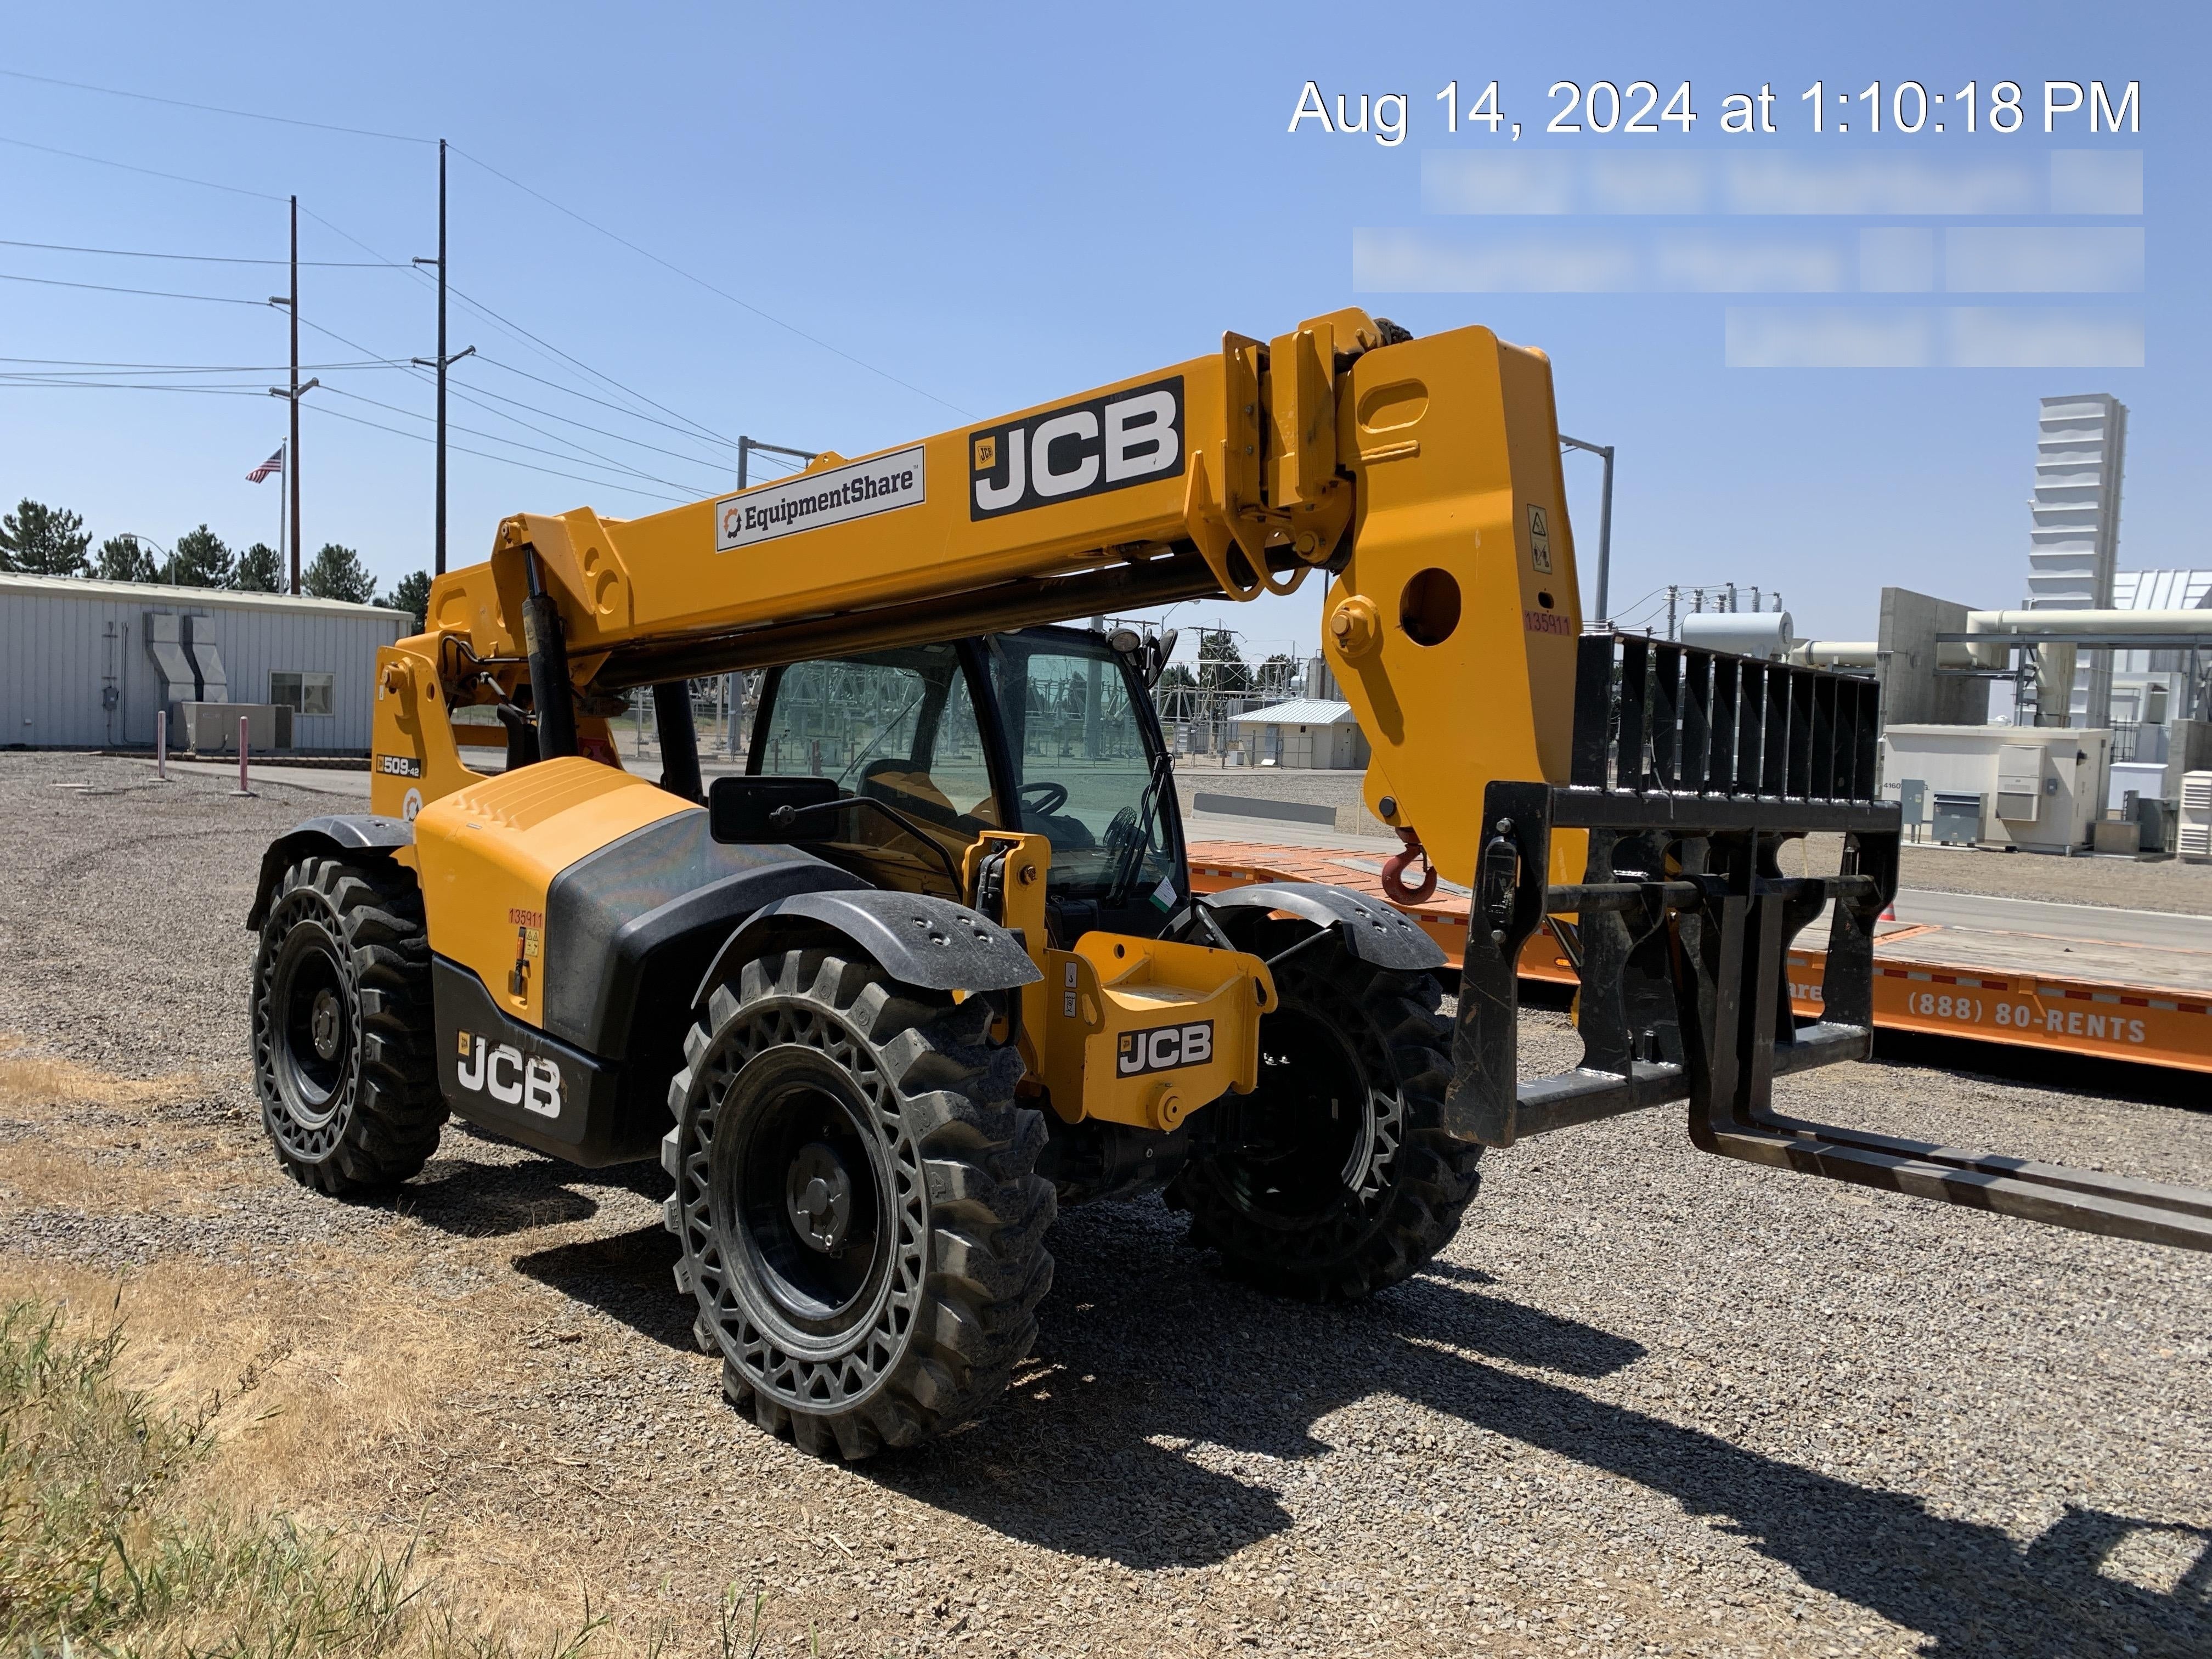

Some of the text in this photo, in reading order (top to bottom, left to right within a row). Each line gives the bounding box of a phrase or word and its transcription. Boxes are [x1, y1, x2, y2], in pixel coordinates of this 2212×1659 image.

[975, 391, 1179, 510] JCB
[744, 470, 913, 531] EquipmentShare
[1525, 611, 1570, 635] 135911
[510, 908, 543, 928] 135911
[1789, 983, 1823, 1001] are
[1909, 991, 1982, 1023] (888)
[1120, 1024, 1211, 1074] JCB
[458, 1036, 561, 1119] JCB
